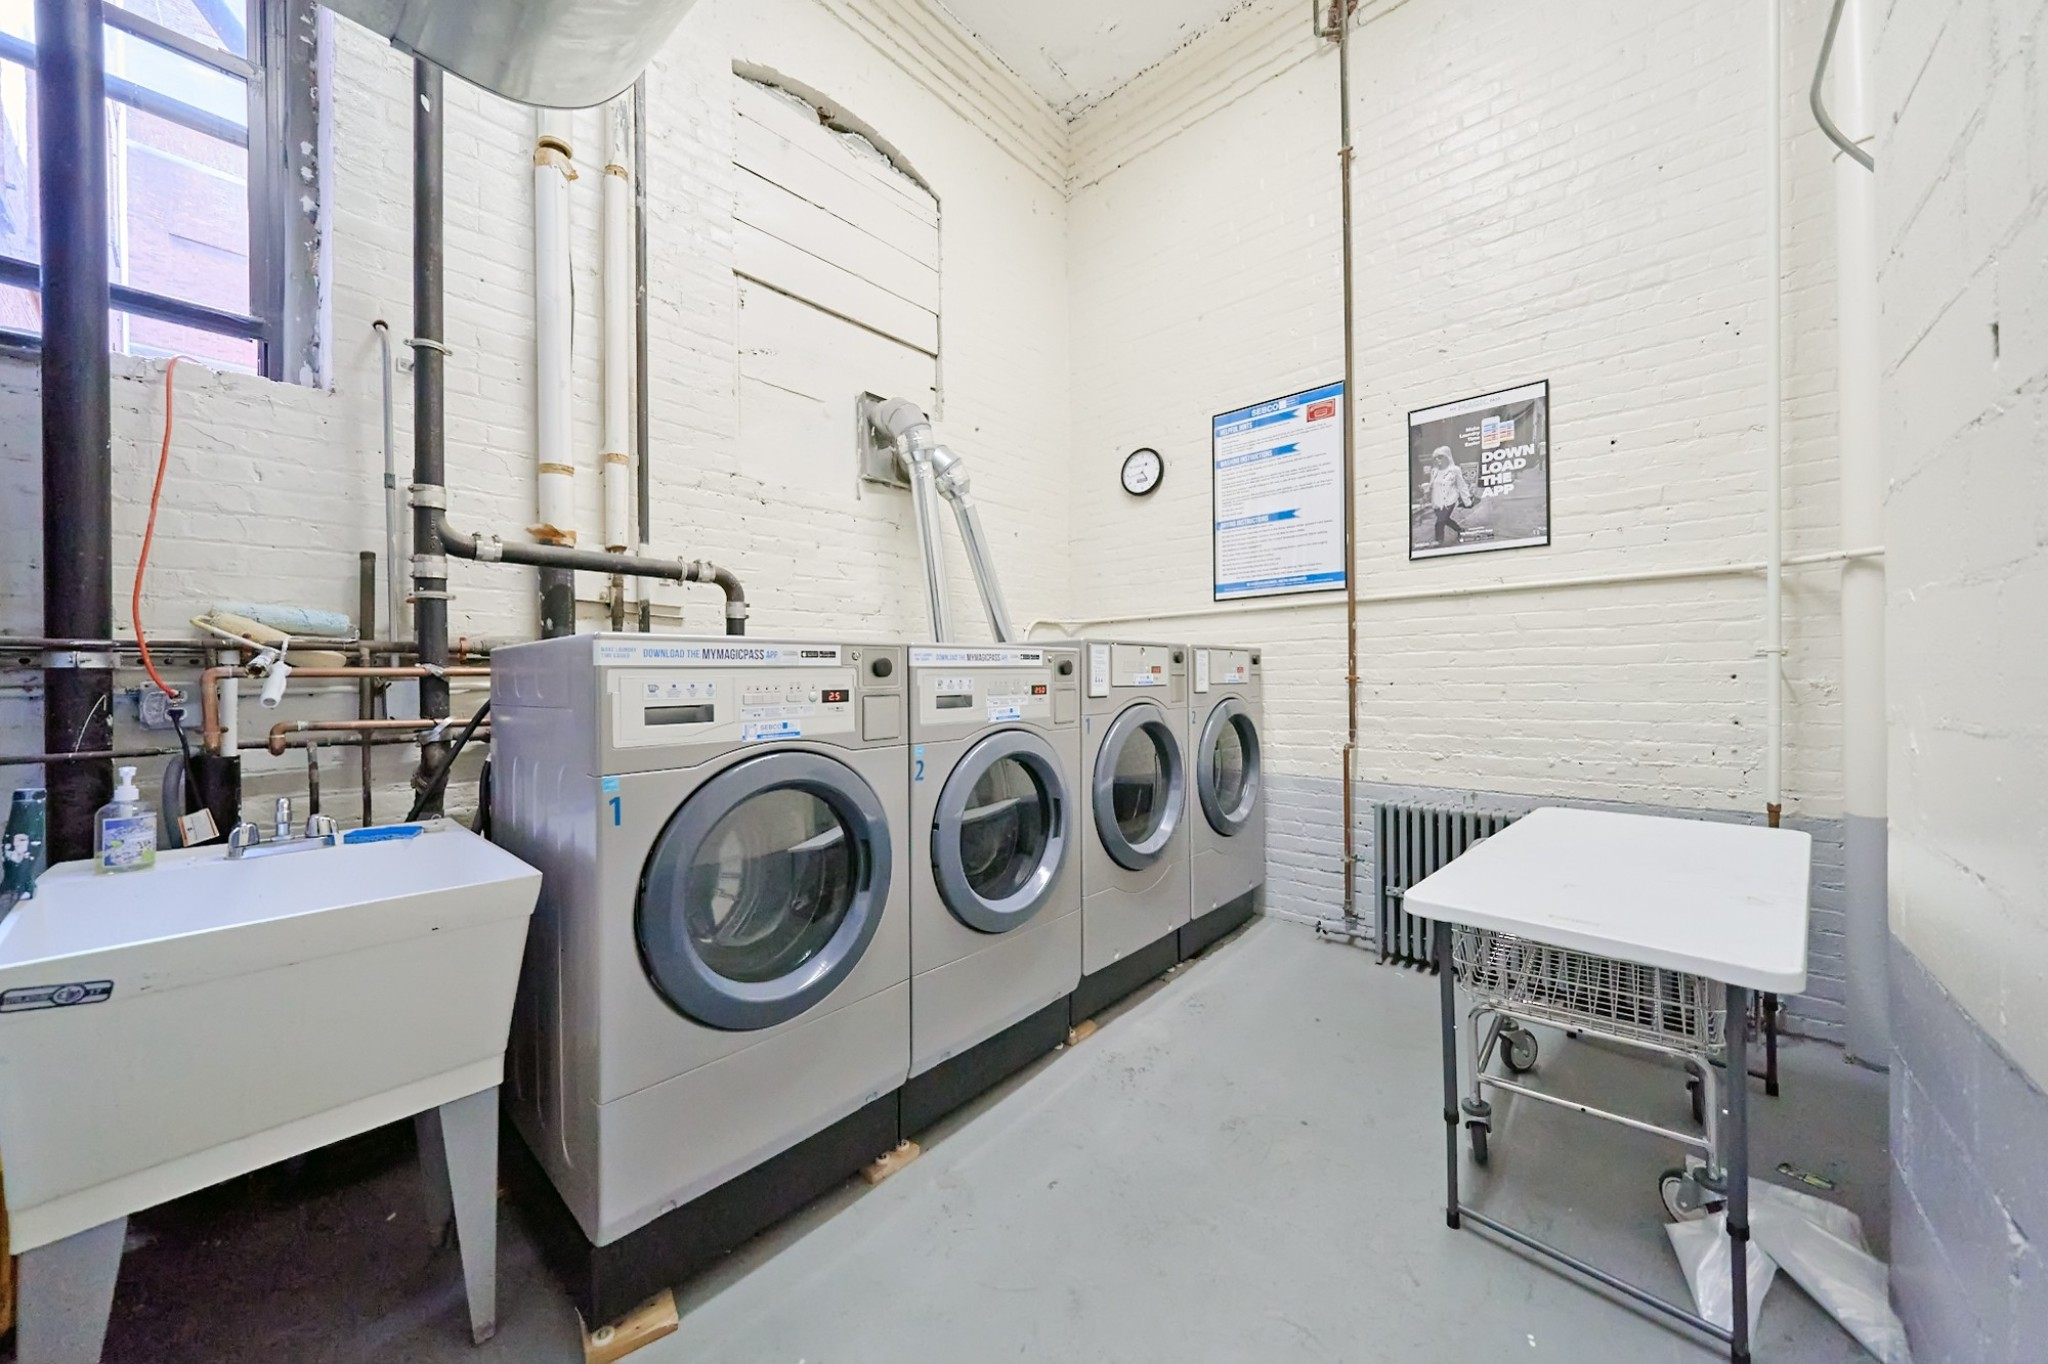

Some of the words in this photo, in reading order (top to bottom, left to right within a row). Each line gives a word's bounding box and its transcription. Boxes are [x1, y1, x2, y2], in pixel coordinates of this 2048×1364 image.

[1251, 403, 1280, 417] SEBCO
[1481, 443, 1535, 463] DOWN
[1481, 457, 1527, 475] LOAD
[1480, 471, 1512, 487] THE
[1481, 483, 1514, 499] APP
[643, 648, 685, 658] DOWNLOAD
[686, 649, 700, 659] THE
[701, 648, 765, 660] MYMAGICPASS
[765, 650, 778, 659] APP
[828, 691, 841, 701] 25
[760, 723, 781, 731] SEBCO
[1085, 717, 1091, 735] 1
[914, 759, 925, 781] 2
[608, 796, 621, 826] 1
